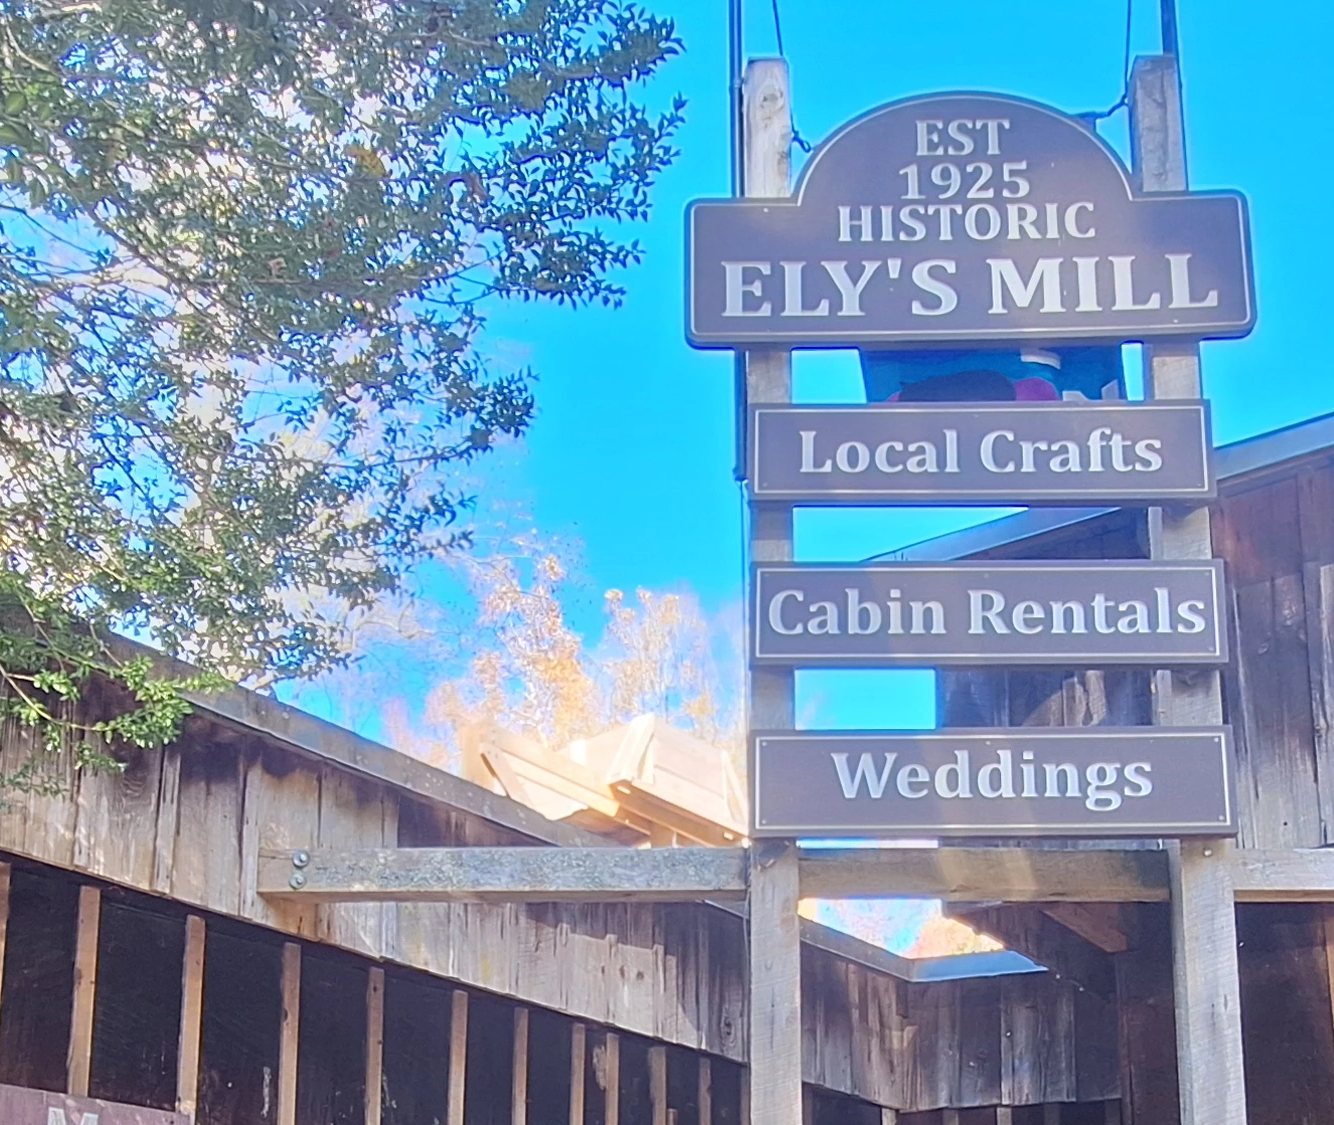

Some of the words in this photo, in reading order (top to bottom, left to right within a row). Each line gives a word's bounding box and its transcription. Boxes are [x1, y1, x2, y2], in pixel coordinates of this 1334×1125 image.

[915, 118, 1010, 156] EST
[899, 160, 1030, 199] 1925
[837, 202, 1096, 242] HISTORIC
[721, 258, 958, 317] ELY'S
[986, 253, 1218, 314] MILL
[799, 429, 960, 473] Local
[980, 427, 1163, 472] Crafts
[768, 588, 946, 635] Cabin
[967, 587, 1206, 634] Rentals
[831, 750, 1153, 811] Weddings
